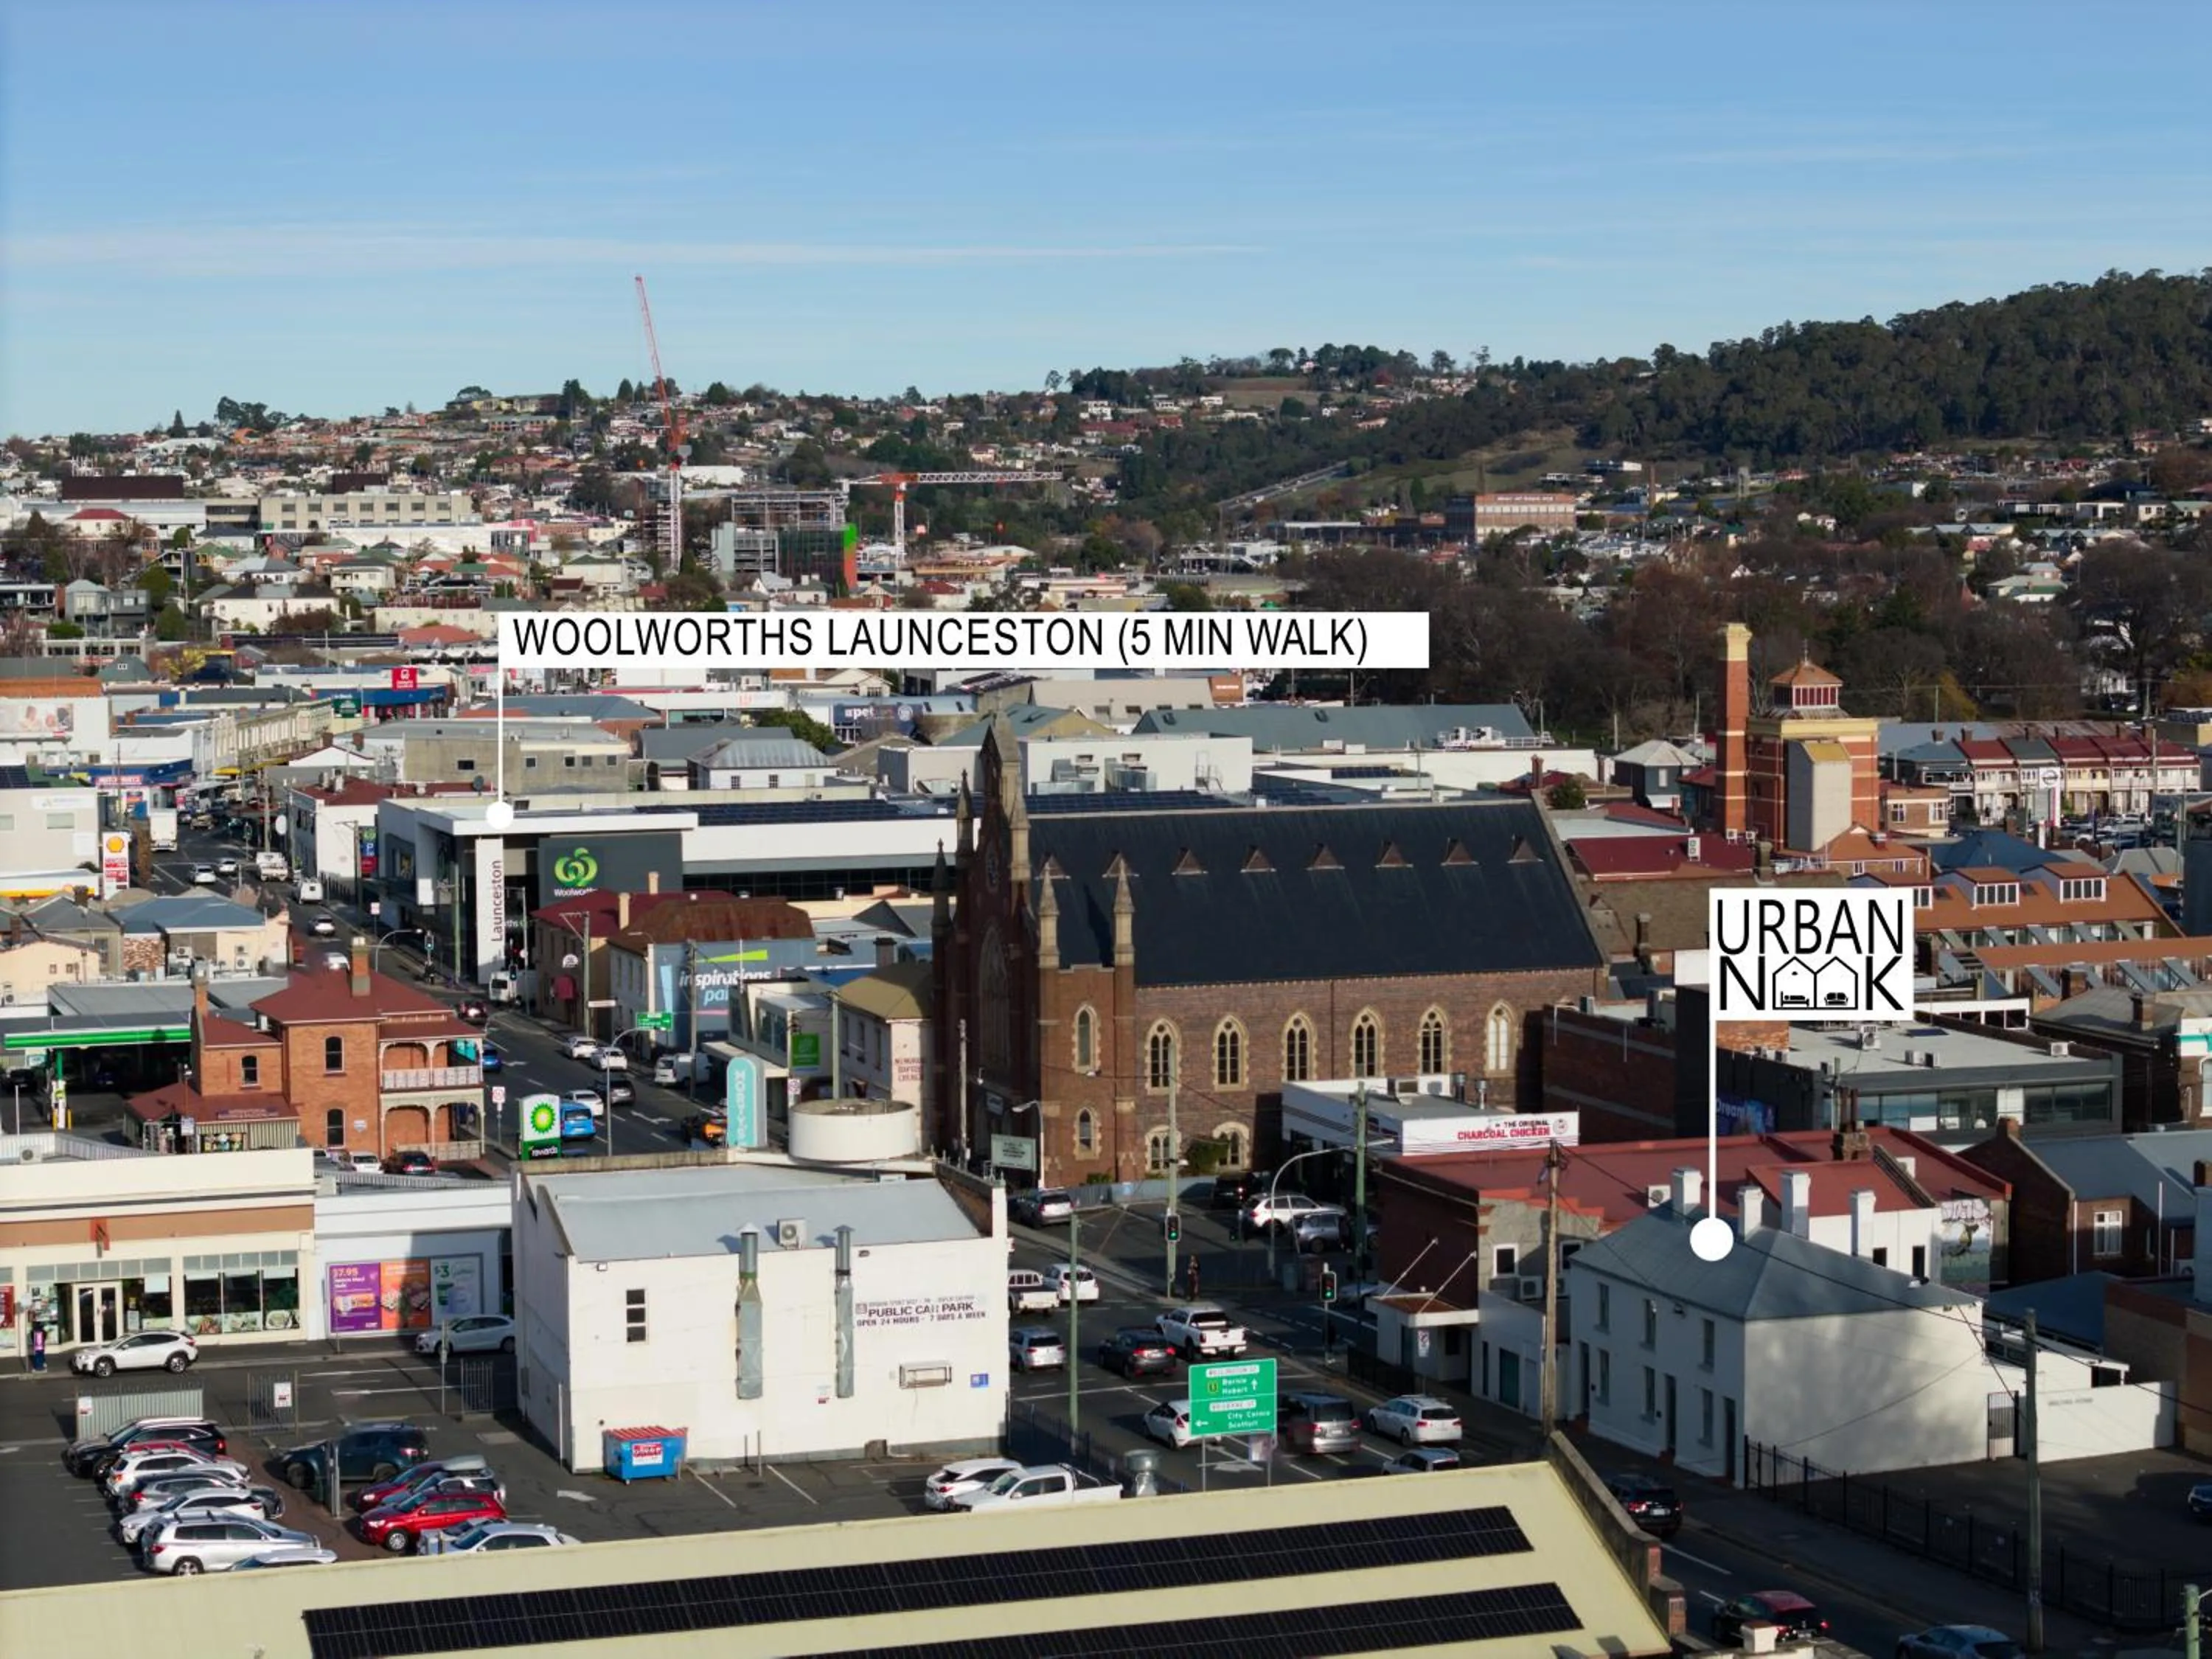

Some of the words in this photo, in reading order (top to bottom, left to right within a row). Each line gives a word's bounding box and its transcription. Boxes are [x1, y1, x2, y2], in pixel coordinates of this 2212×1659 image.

[554, 888, 598, 897] Woolwor
[491, 860, 503, 942] Launceston
[1518, 1119, 1548, 1127] ORIGINAL
[1457, 1129, 1508, 1141] CHARCOAL
[1509, 1127, 1551, 1138] CHICKEN
[868, 1305, 912, 1318] PUBLIC
[942, 1301, 974, 1312] PARK
[893, 1316, 919, 1324] HOURS
[937, 1313, 955, 1321] DAYS
[965, 1311, 986, 1319] WEEK
